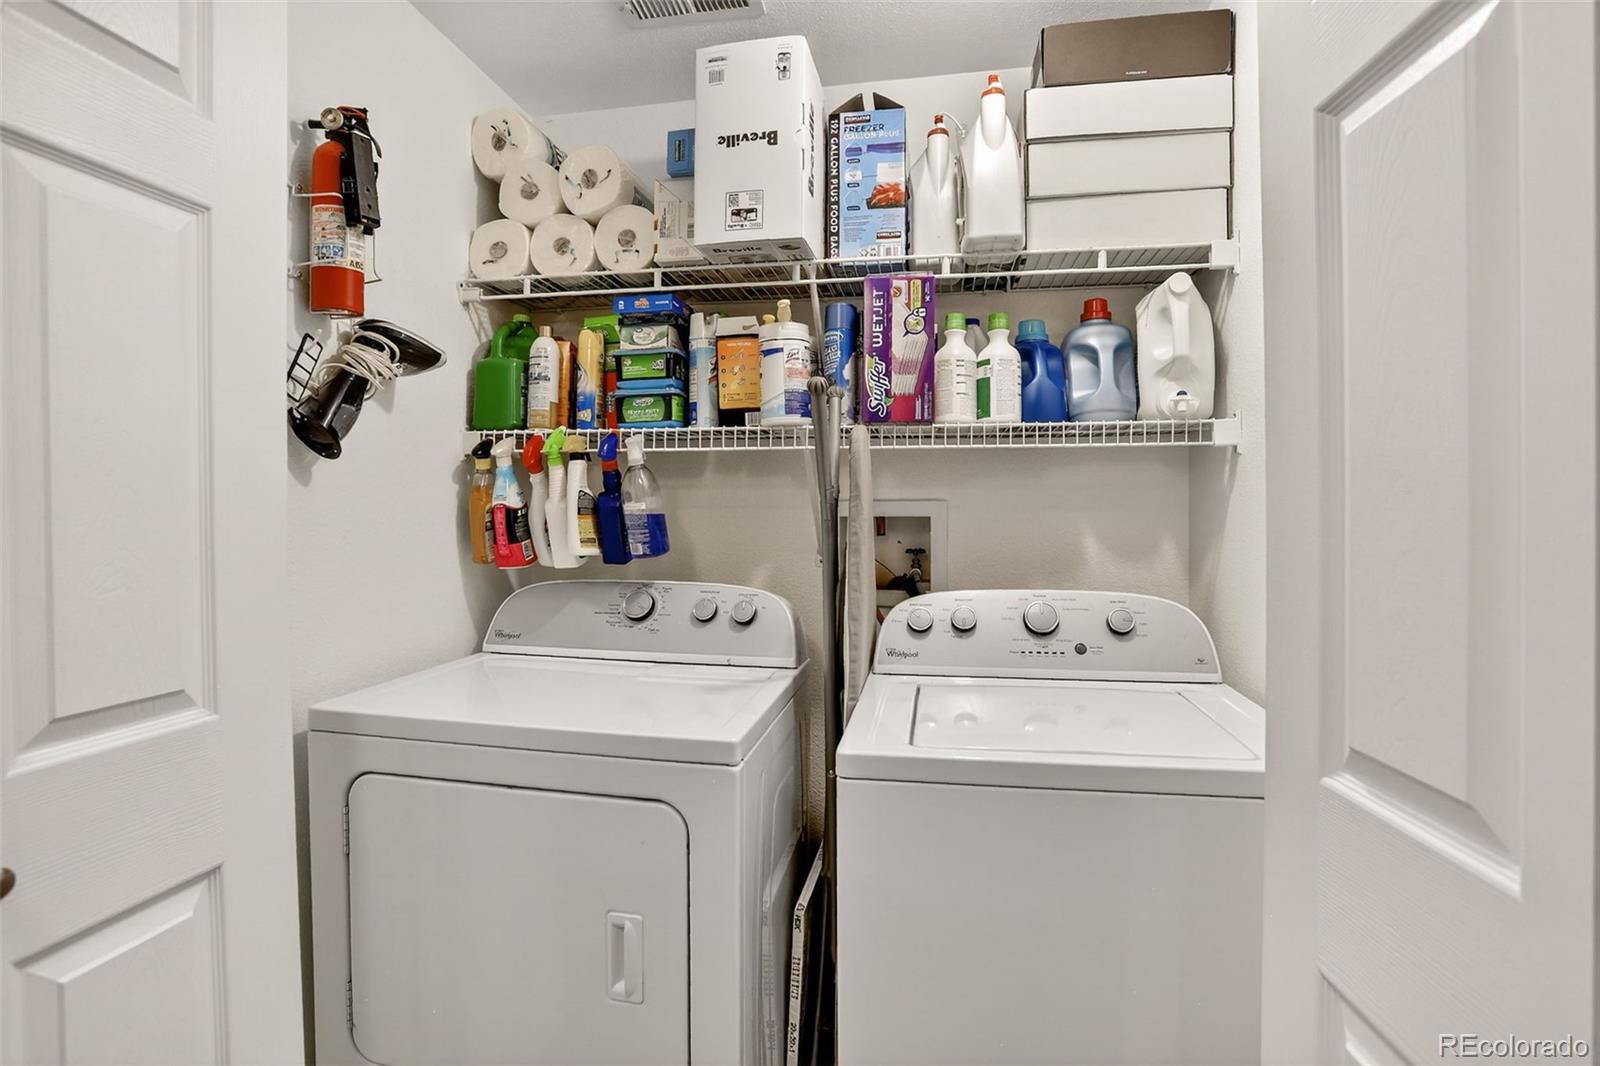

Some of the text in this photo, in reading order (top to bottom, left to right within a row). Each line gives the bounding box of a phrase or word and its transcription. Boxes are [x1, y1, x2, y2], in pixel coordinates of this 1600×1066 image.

[830, 119, 839, 134] 192
[844, 123, 885, 133] FREEZER
[718, 130, 778, 148] Breville
[830, 137, 839, 176] GALLON
[830, 179, 839, 202] PLUS
[830, 205, 838, 232] FOOD
[872, 289, 884, 348] WETJET
[868, 355, 890, 418] Swiffer
[886, 648, 919, 660] Whirlpool
